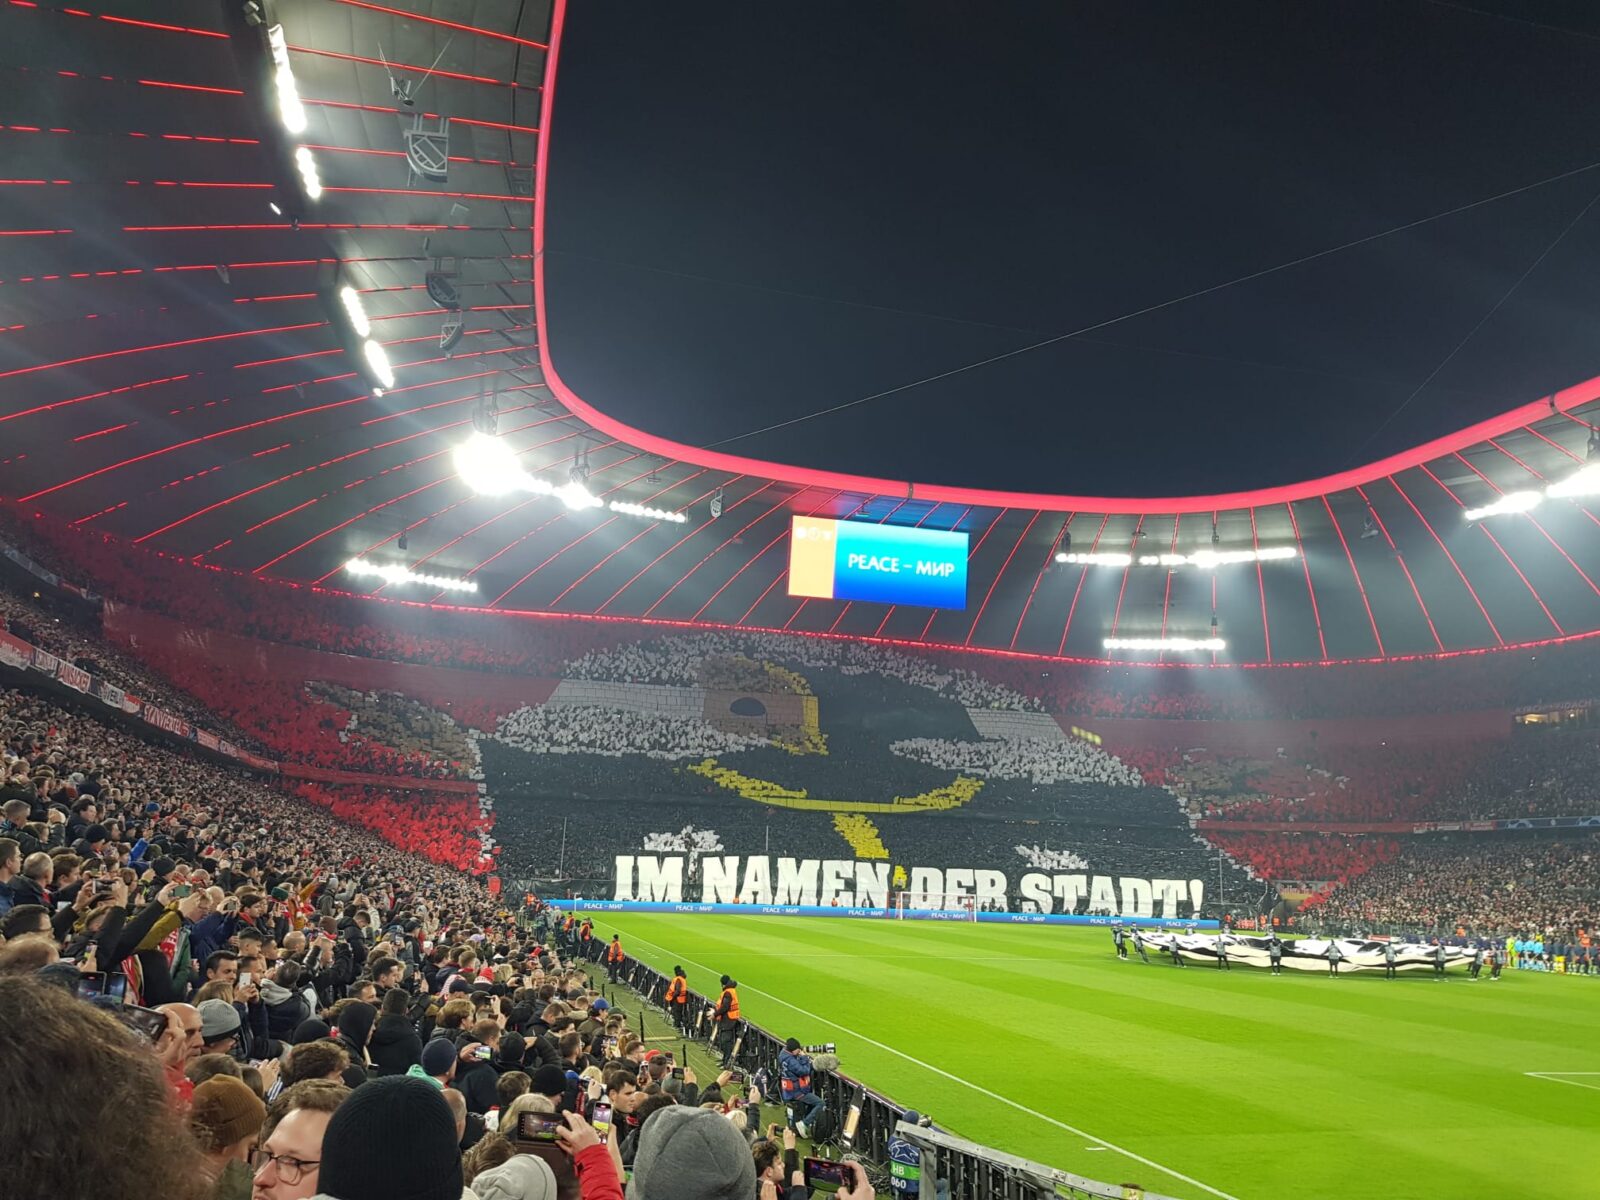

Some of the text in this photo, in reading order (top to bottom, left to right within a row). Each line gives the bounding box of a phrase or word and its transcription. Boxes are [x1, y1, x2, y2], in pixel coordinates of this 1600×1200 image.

[848, 553, 900, 573] PEACE
[916, 560, 955, 577] МИР
[614, 855, 1204, 920] IM NAMEN DER STADT!
[891, 1176, 907, 1189] 060
